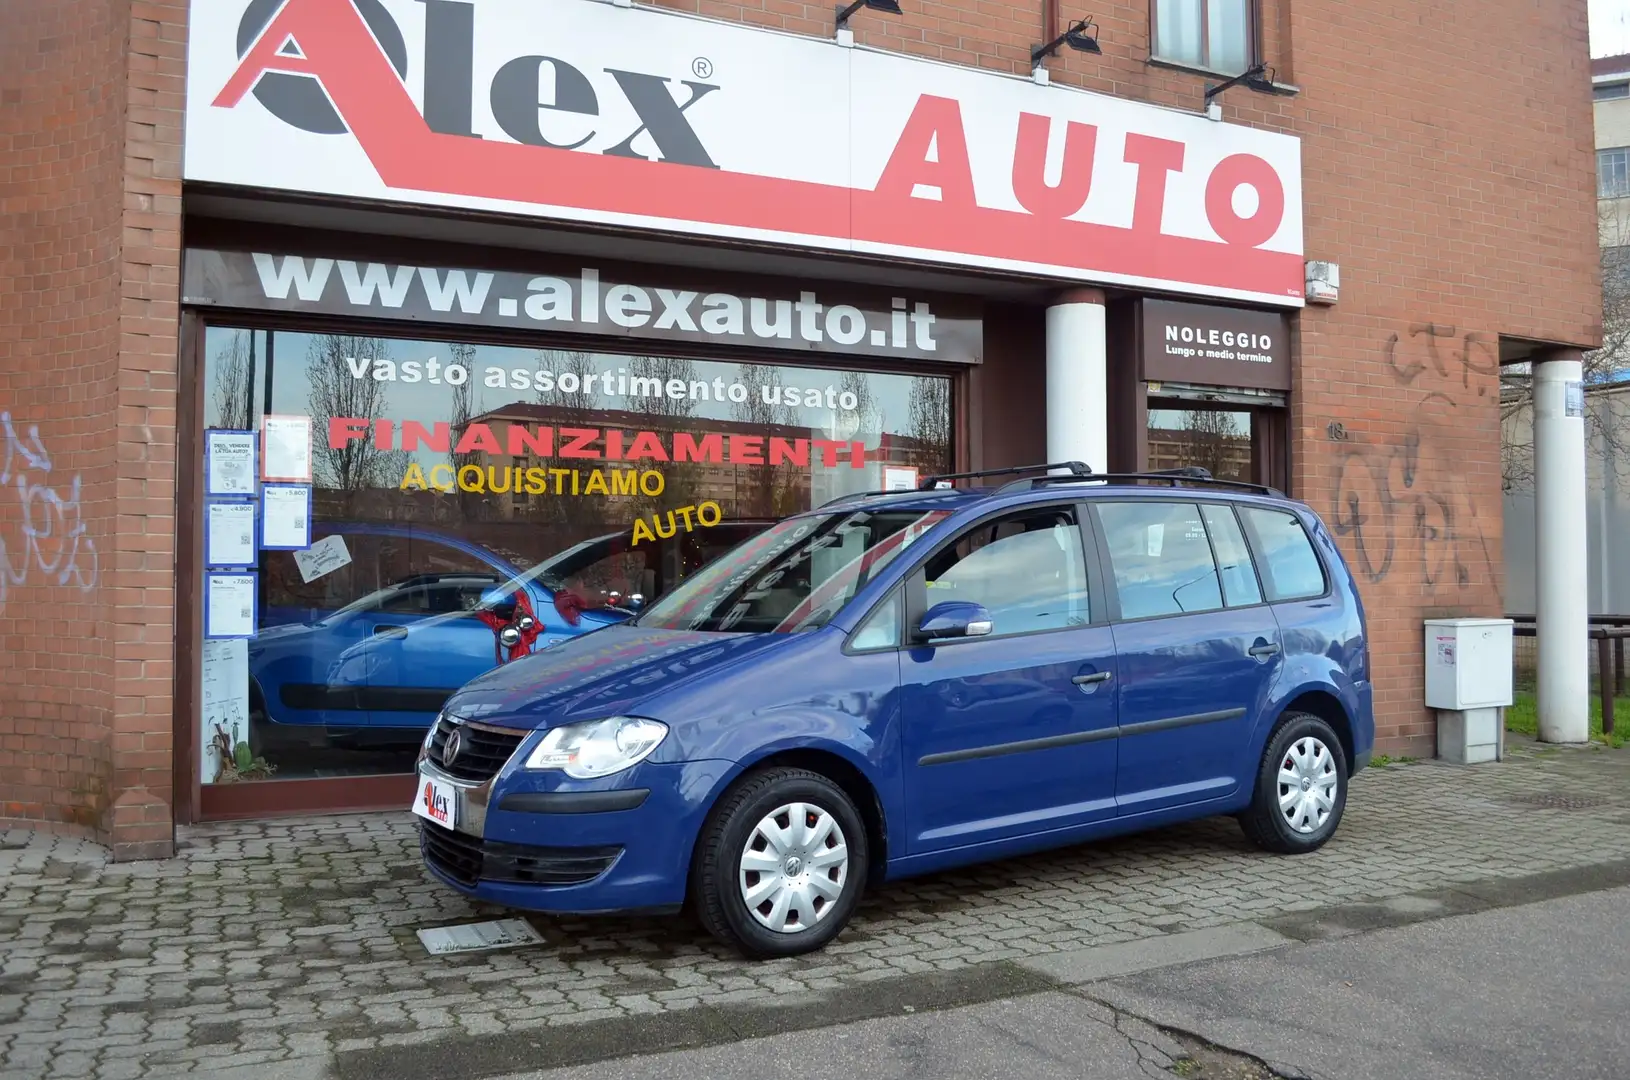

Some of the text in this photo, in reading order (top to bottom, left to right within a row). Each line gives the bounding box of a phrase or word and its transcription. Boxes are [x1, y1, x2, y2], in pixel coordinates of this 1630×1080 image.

[211, 0, 720, 170] Alex
[873, 93, 1285, 249] AUTO
[251, 252, 936, 351] www.alexauto.it
[1165, 325, 1272, 350] NOLEGGIO
[1165, 345, 1195, 358] Lungo
[1206, 350, 1234, 360] medio
[1236, 352, 1273, 363] termine
[347, 355, 859, 411] vasto assortimento usato
[329, 416, 866, 470] FINANZIAMENTI
[400, 462, 665, 496] ACQUISTIAMO
[631, 500, 722, 546] AUTO
